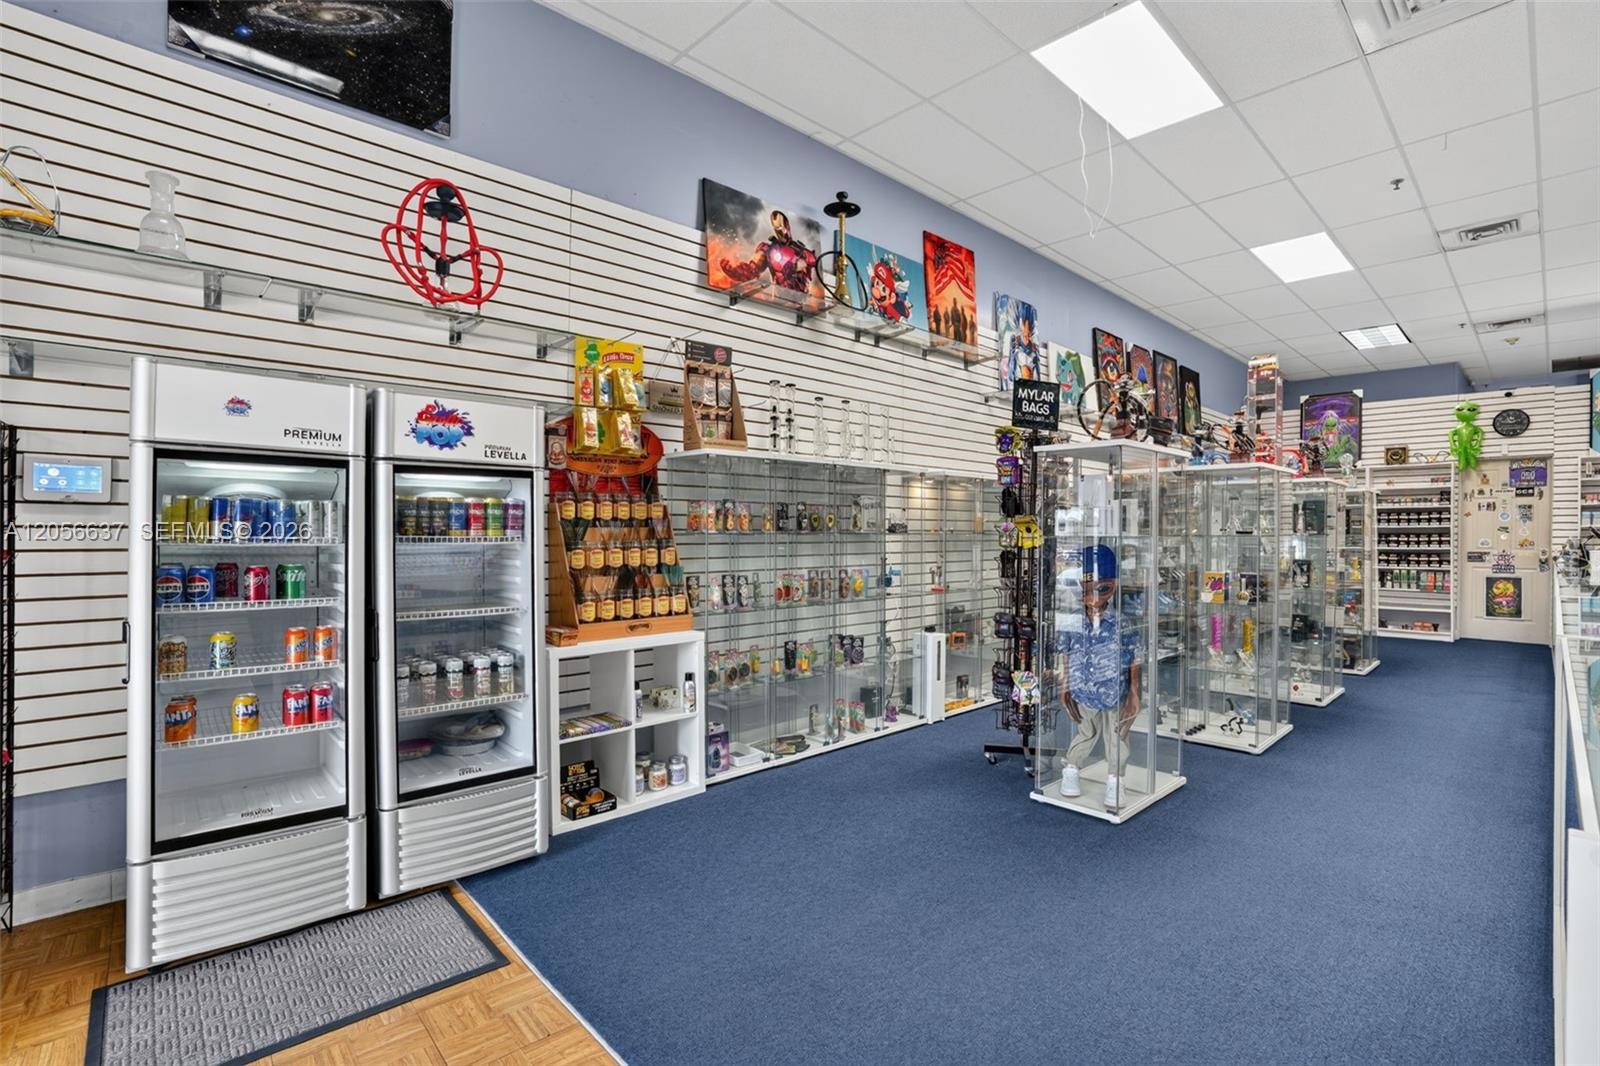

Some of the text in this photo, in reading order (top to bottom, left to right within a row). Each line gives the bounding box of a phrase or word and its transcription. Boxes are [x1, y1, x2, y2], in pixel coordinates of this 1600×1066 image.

[1018, 388, 1054, 403] MYLAR
[1022, 400, 1050, 415] BAGS
[284, 428, 341, 442] PREMIUM
[484, 450, 527, 461] LEVELLA
